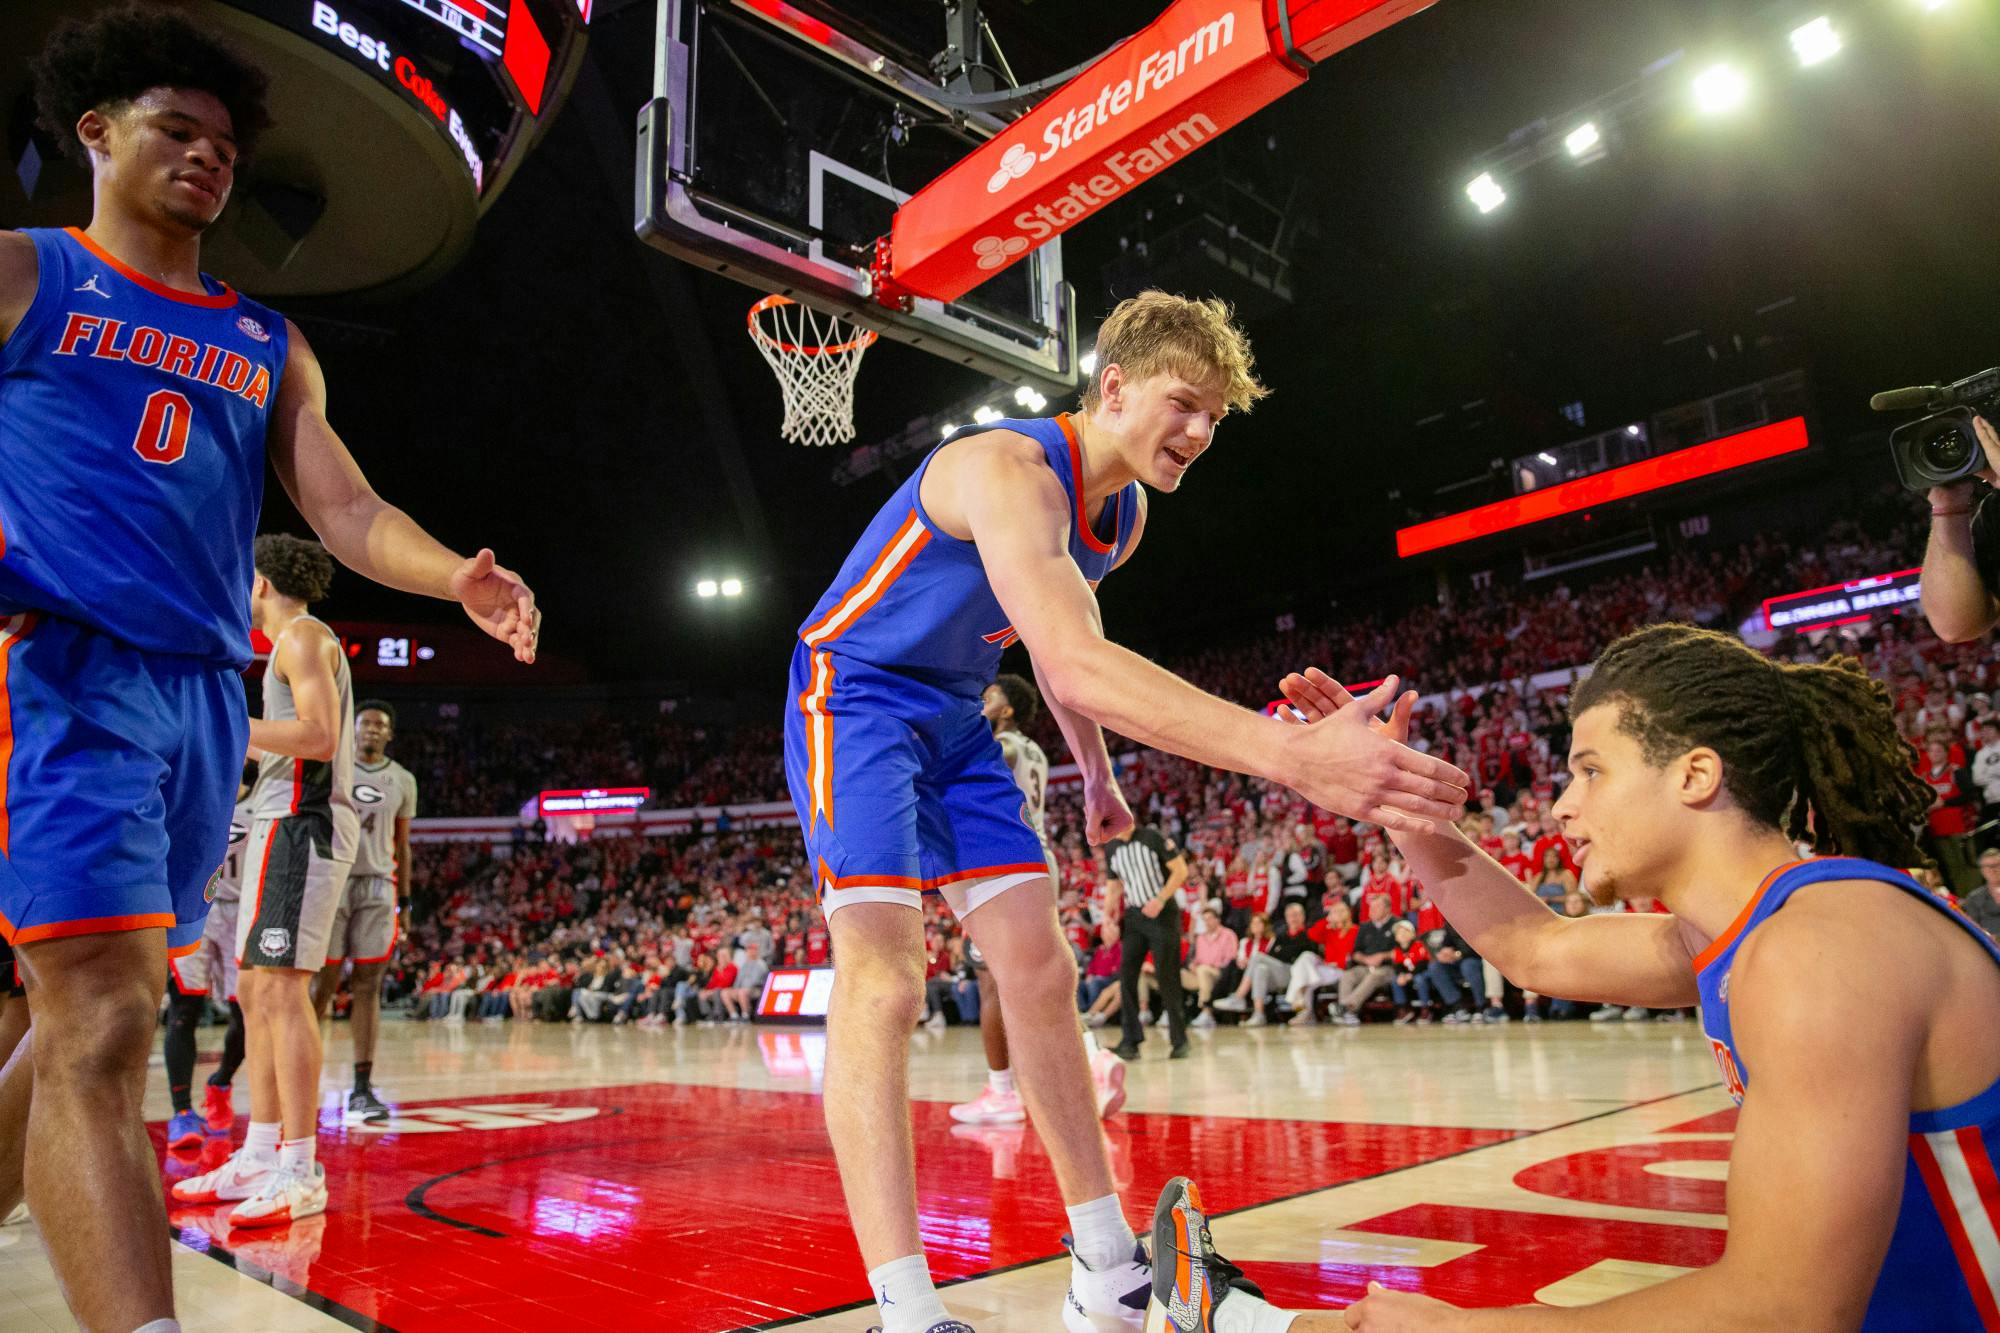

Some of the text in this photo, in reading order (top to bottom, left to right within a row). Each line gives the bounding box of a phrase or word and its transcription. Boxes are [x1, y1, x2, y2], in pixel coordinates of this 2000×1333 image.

[311, 0, 391, 71] Best
[395, 56, 448, 122] Coke
[52, 312, 271, 409] FLORIDA
[132, 388, 193, 465] 0
[377, 637, 409, 658] 21
[352, 784, 385, 804] G
